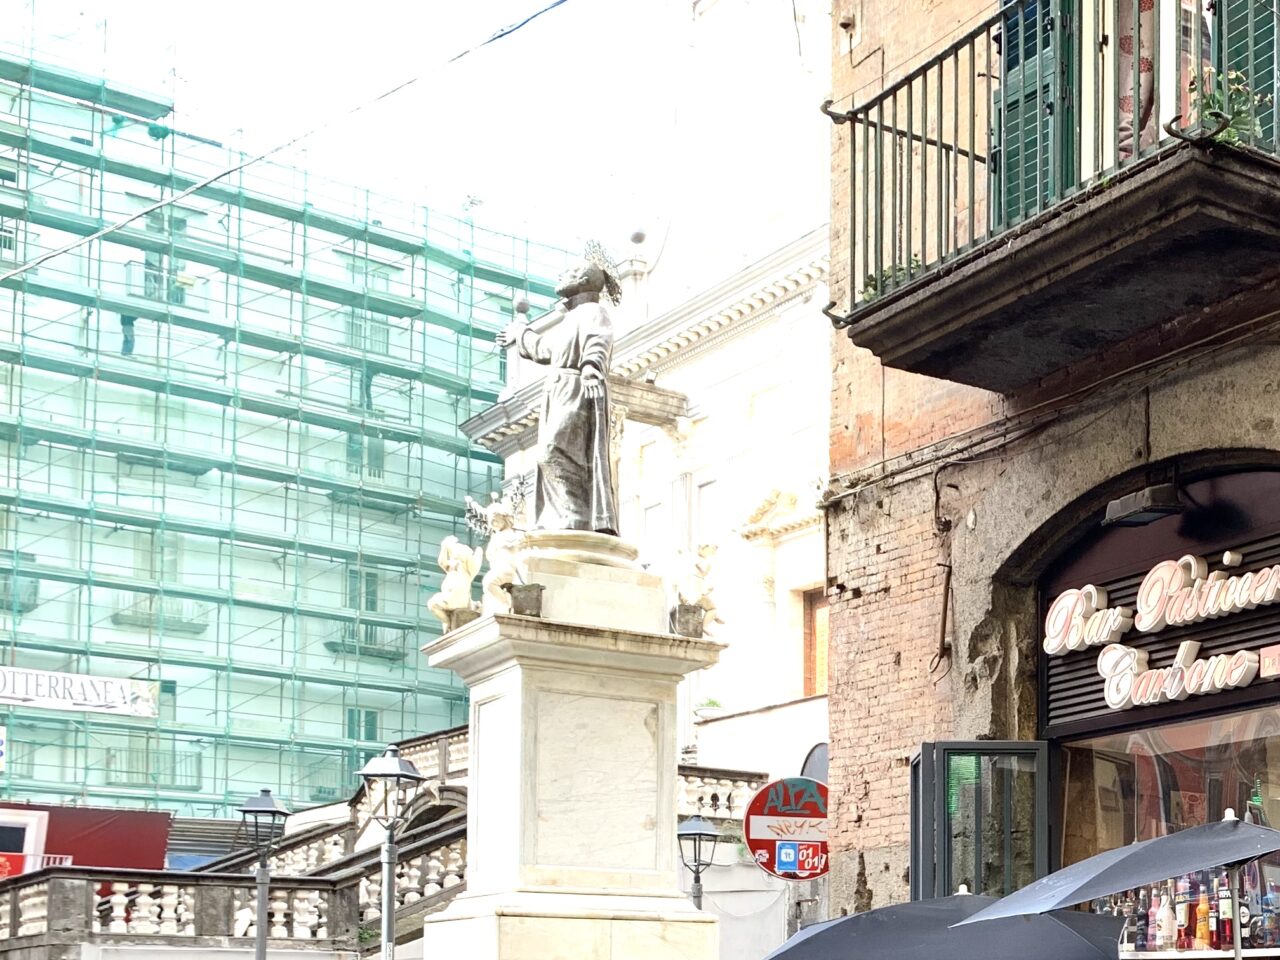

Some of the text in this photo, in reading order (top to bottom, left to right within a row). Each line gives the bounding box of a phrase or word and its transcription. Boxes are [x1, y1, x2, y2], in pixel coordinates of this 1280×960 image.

[1043, 584, 1133, 656] Bar
[1097, 640, 1260, 711] Carbone
[799, 847, 814, 861] 01
